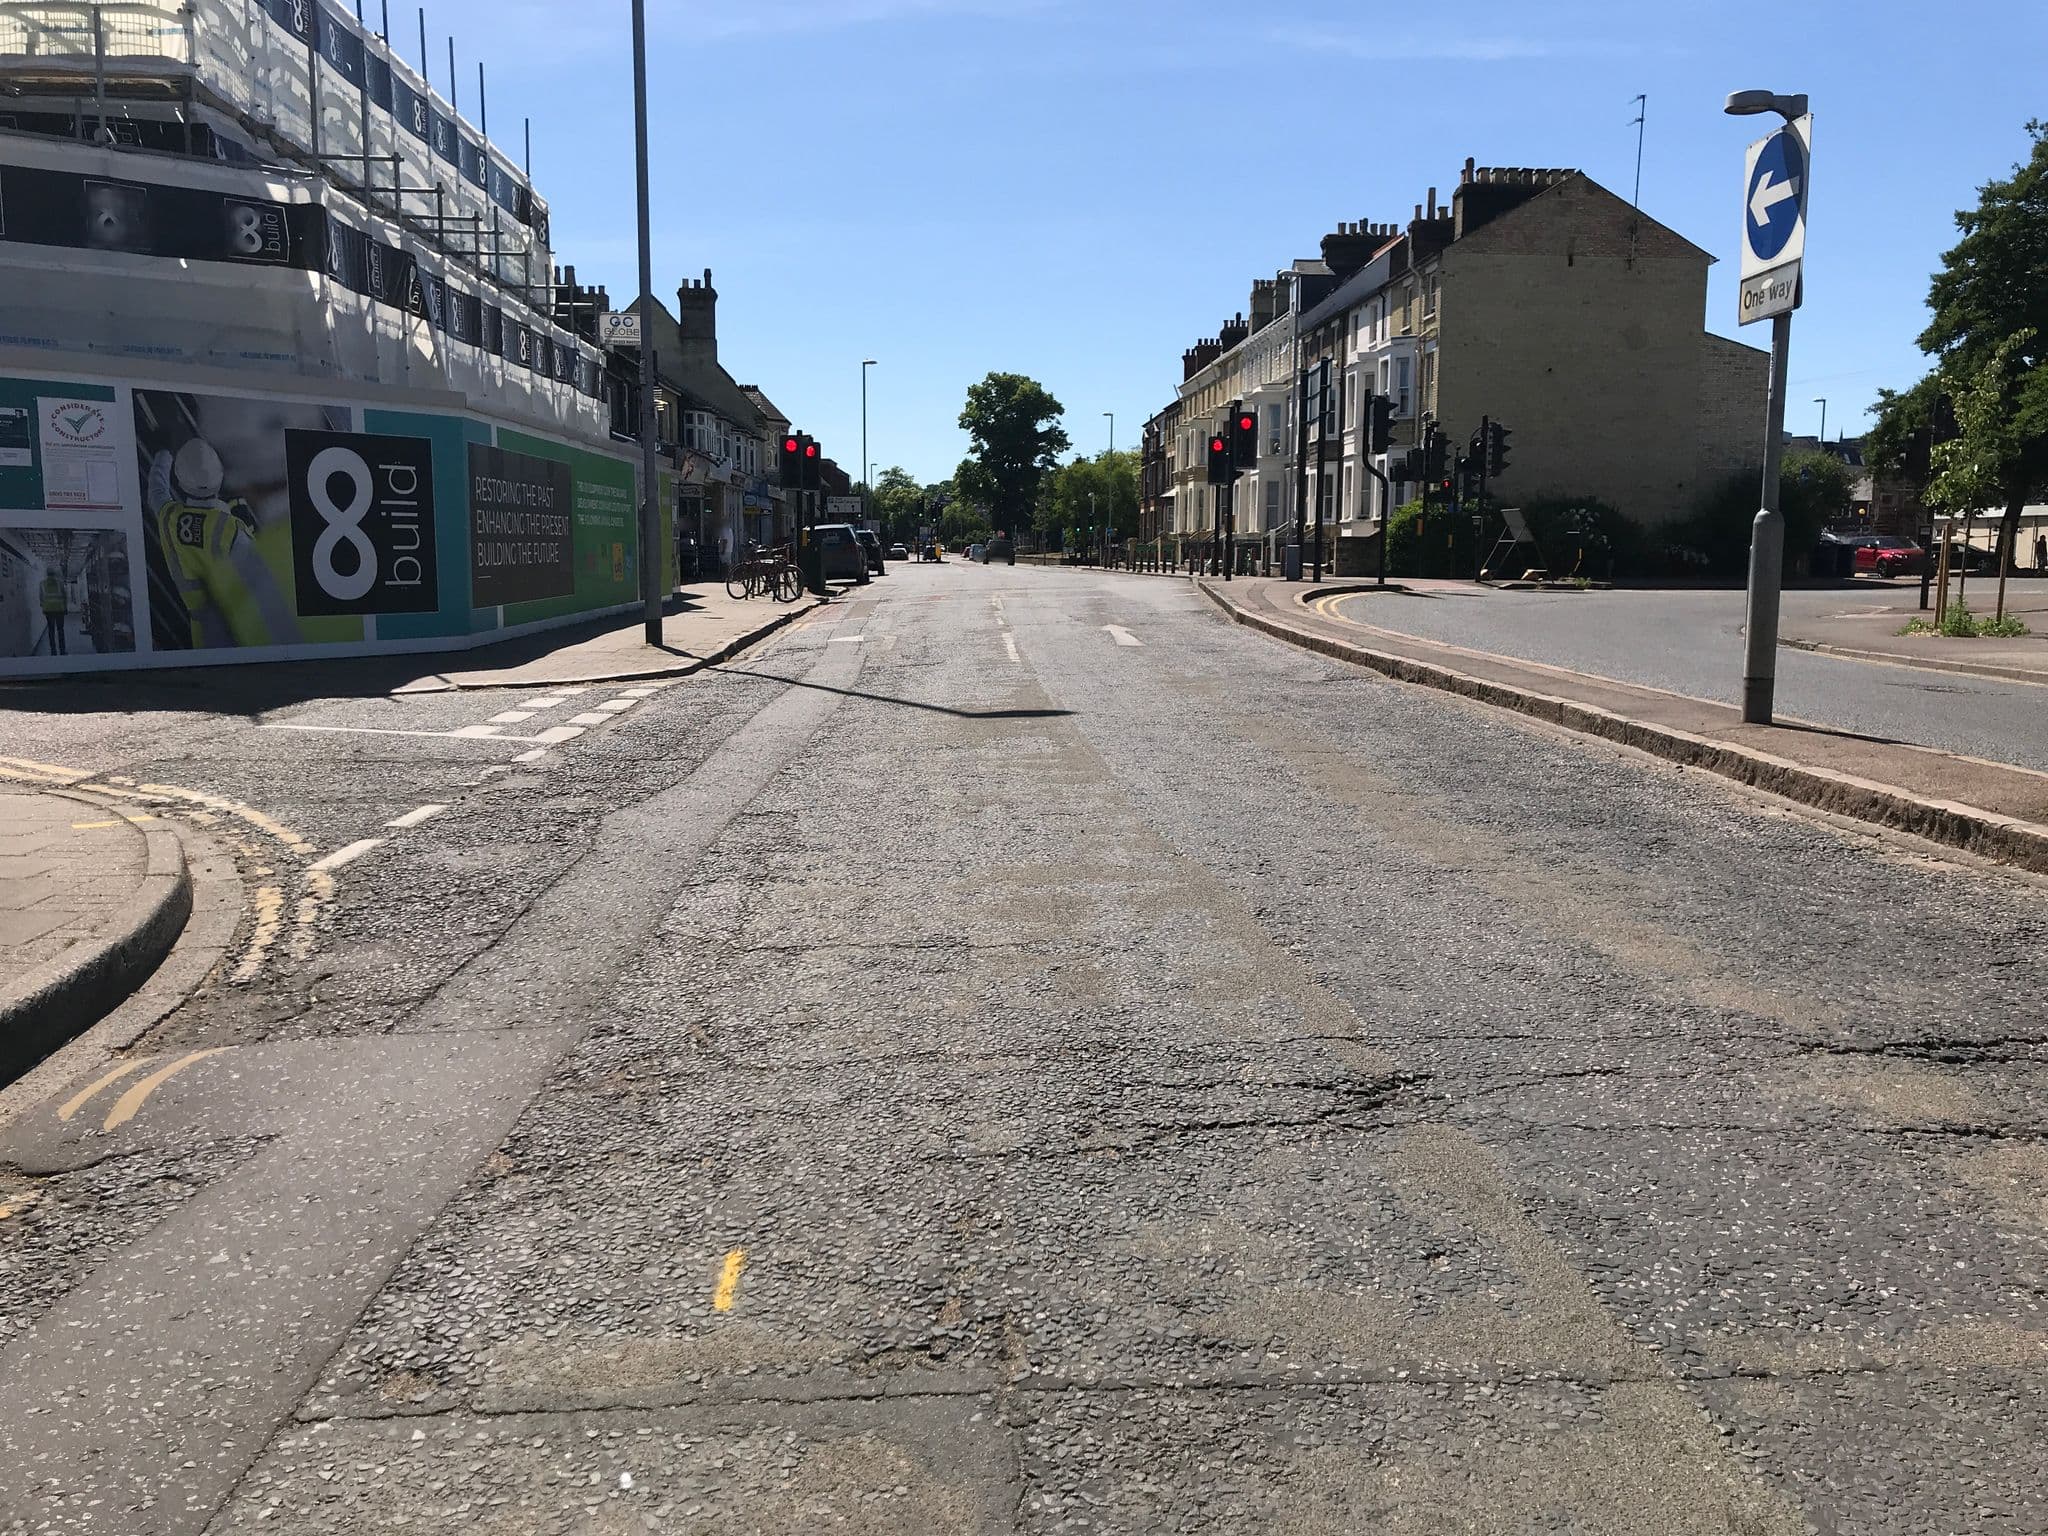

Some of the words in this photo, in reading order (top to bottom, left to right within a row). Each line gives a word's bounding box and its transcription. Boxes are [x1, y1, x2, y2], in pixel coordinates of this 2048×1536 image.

[479, 156, 486, 184] 8
[263, 213, 280, 252] build
[1743, 289, 1765, 310] One
[1769, 280, 1793, 301] way
[519, 330, 527, 361] 8
[51, 402, 104, 422] CONSIDERATE
[51, 422, 105, 442] CONSTRUCTORS
[475, 476, 521, 505] RESTORING
[521, 483, 537, 506] THE
[537, 485, 554, 508] PAST
[180, 514, 193, 544] 8
[307, 446, 378, 600] 8
[378, 463, 422, 586] build
[476, 510, 525, 534] ENHANCING
[525, 513, 541, 535] THE
[541, 513, 569, 536] PRESENT
[477, 542, 517, 566] BUILDING
[517, 542, 533, 564] THE
[533, 542, 560, 563] FUTURE
